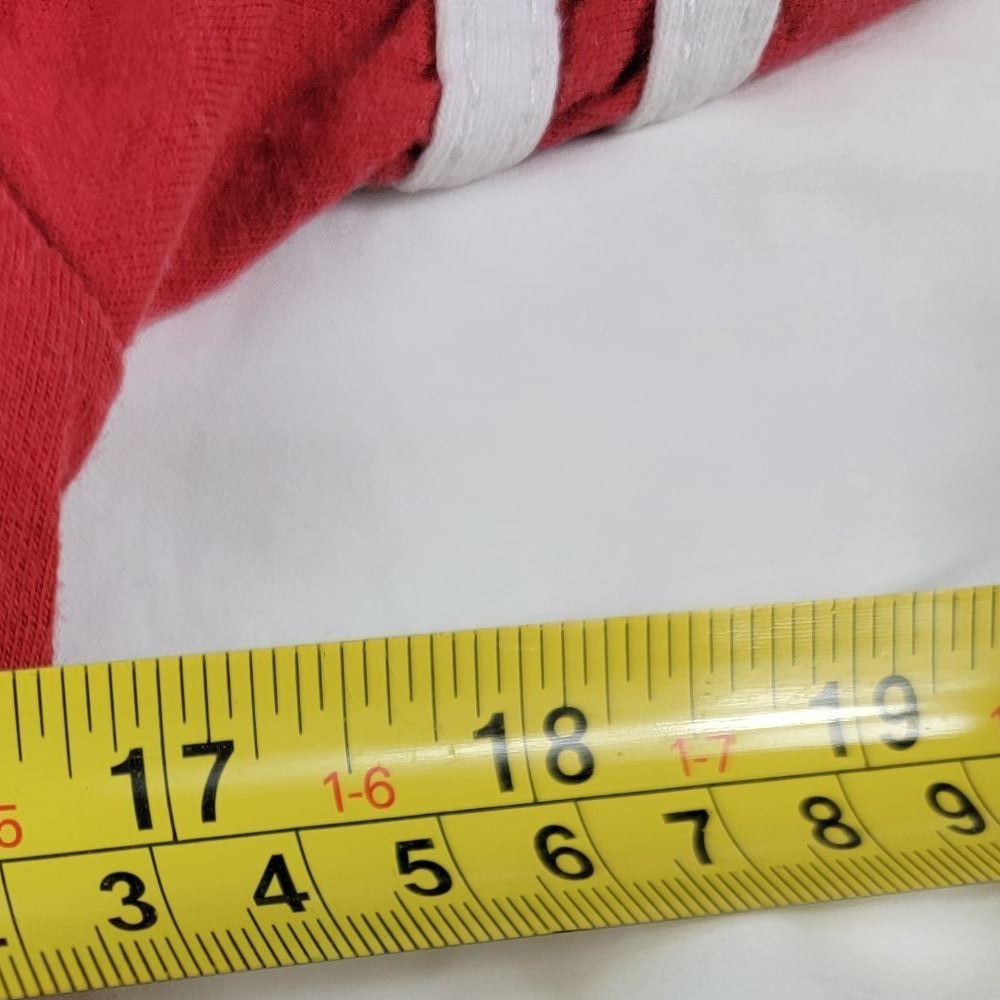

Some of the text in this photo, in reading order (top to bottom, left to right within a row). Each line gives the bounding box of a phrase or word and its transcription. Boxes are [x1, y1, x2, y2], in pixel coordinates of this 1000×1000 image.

[110, 739, 235, 831] 17
[323, 764, 397, 813] 1-6
[473, 705, 596, 793] 18
[672, 734, 736, 777] 1-7
[808, 674, 920, 758] 19
[99, 871, 158, 931] 3
[254, 852, 310, 912] 4
[395, 837, 452, 896] 5
[533, 824, 595, 880] 6
[662, 809, 713, 865] 7
[799, 796, 862, 850] 8
[924, 782, 987, 835] 9
